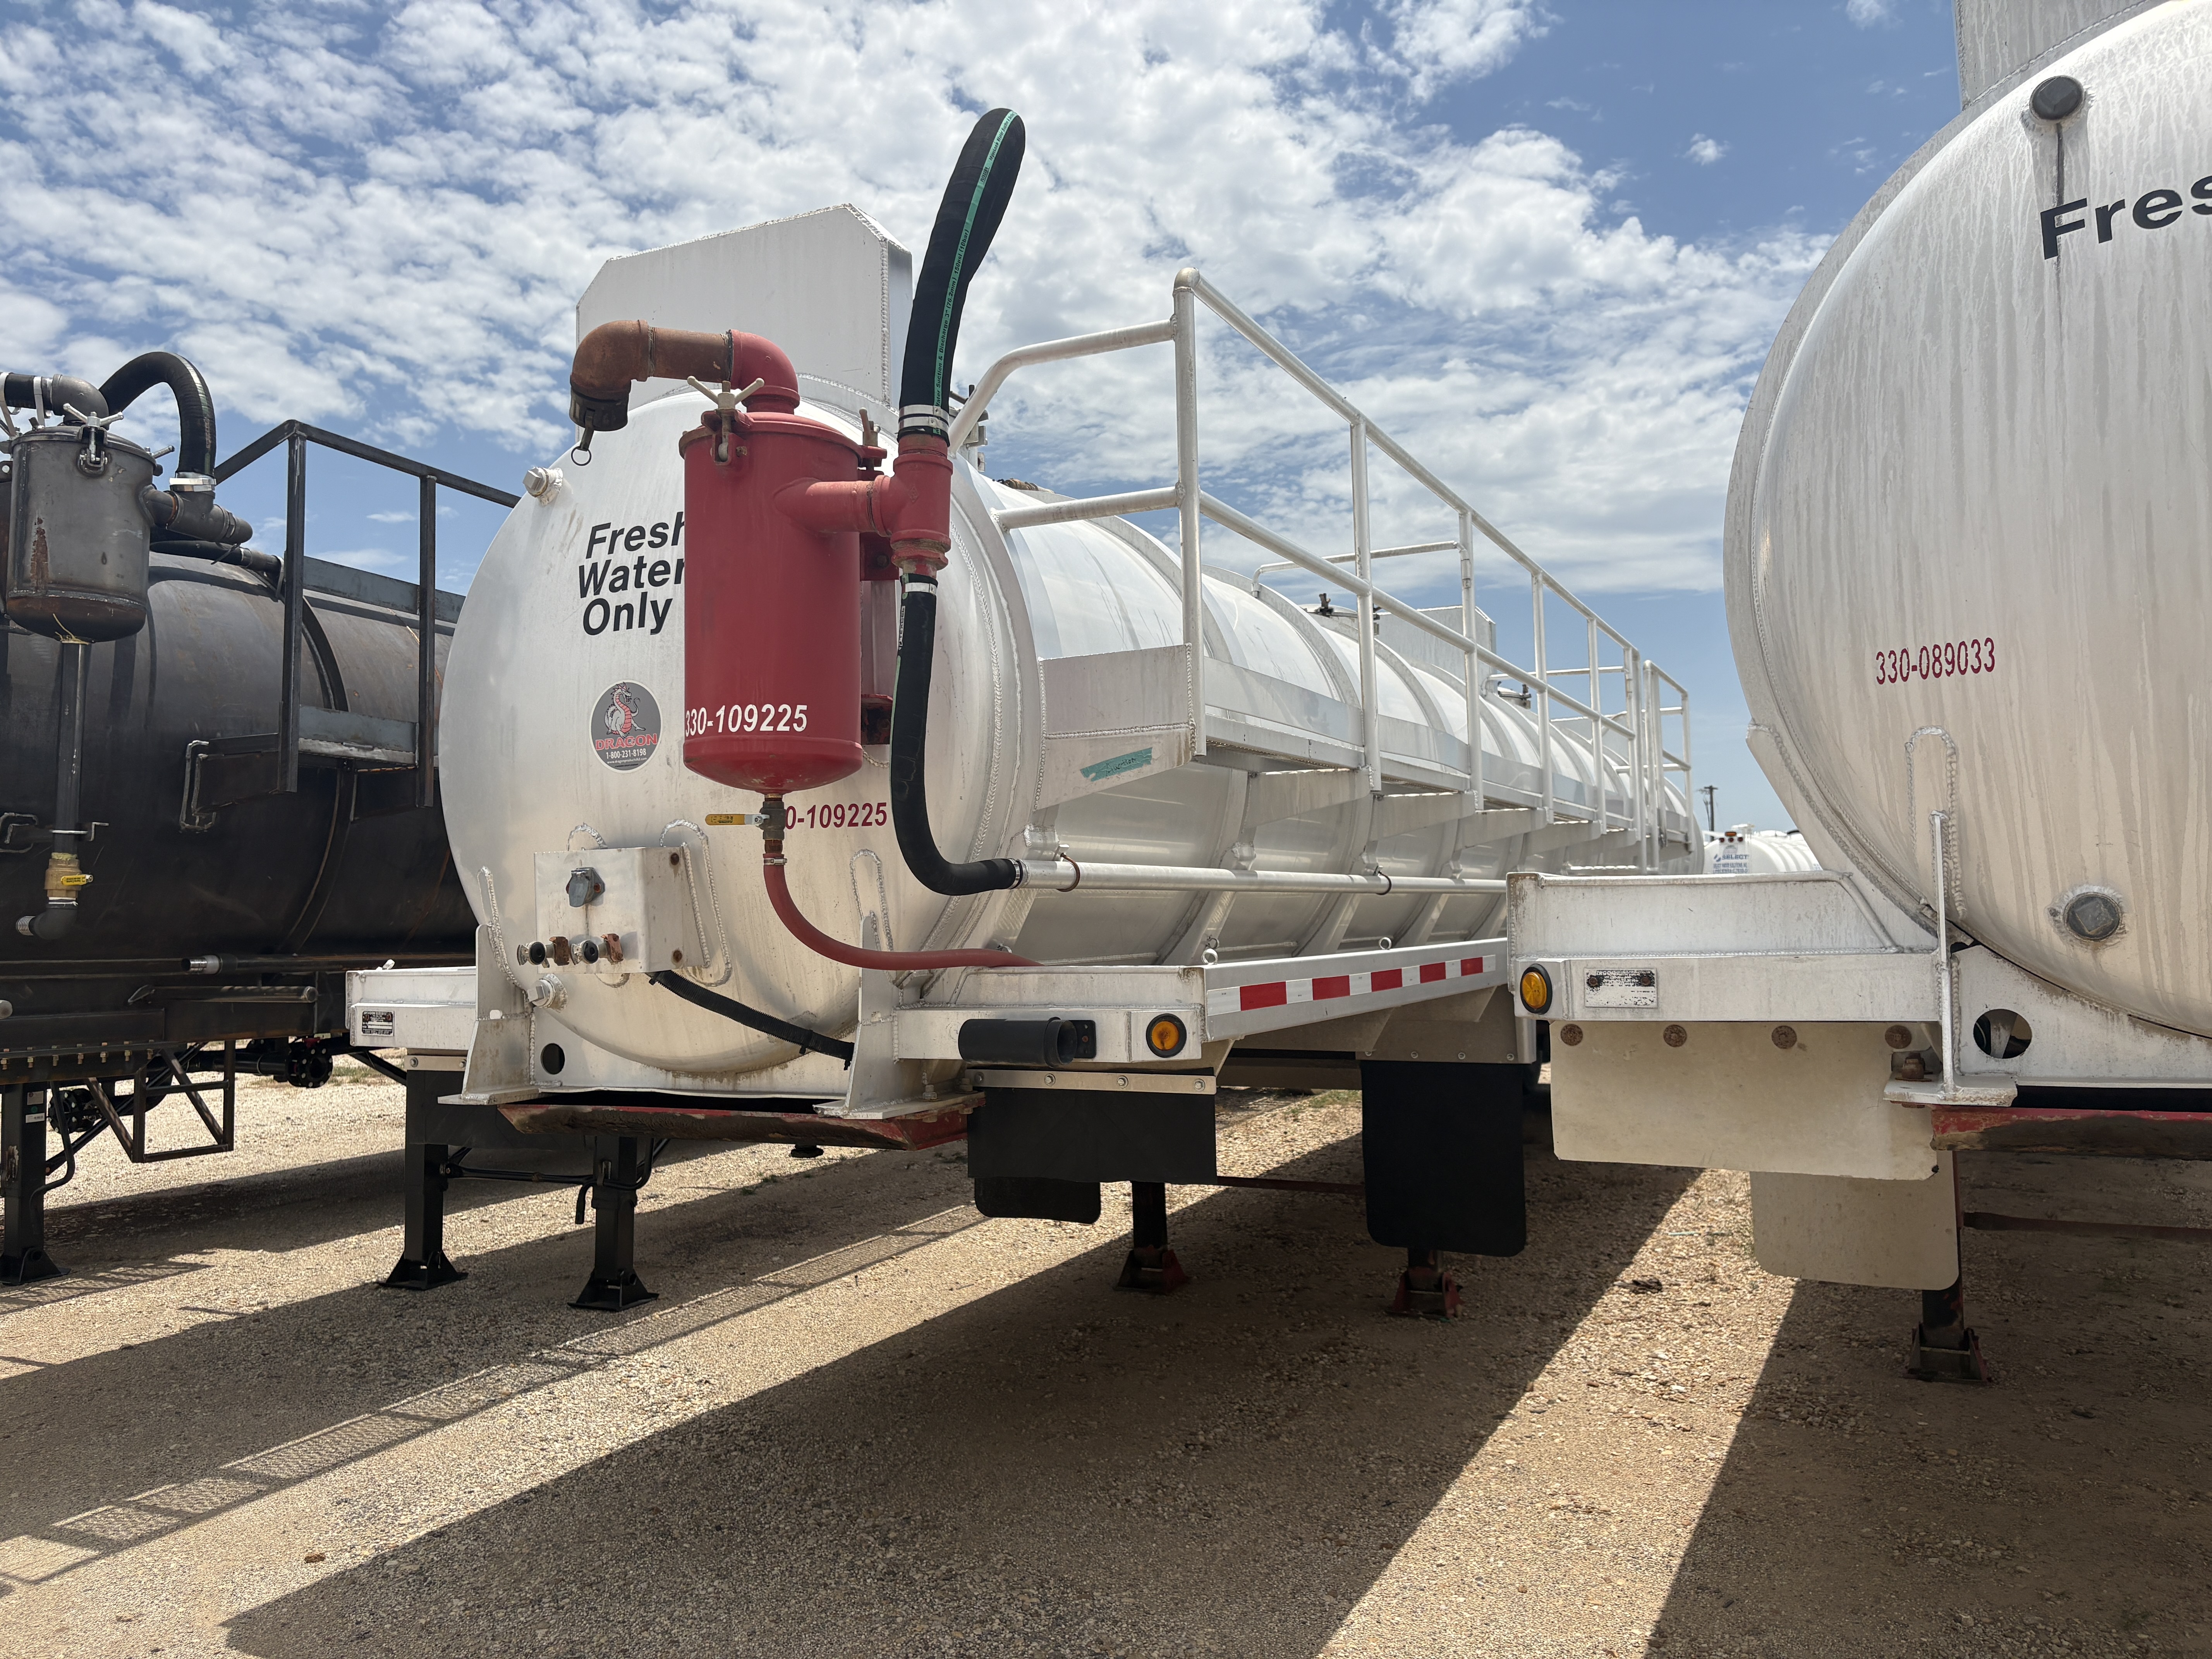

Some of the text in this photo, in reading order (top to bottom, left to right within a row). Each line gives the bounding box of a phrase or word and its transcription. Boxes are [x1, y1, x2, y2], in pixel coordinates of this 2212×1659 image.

[939, 320, 948, 353] Discharge
[959, 229, 969, 252] (10bar)
[586, 511, 685, 559] Fresh
[579, 556, 685, 598] Water
[583, 591, 673, 635] Only
[1876, 637, 1995, 685] 330-089033
[685, 704, 807, 737] 330-109225
[596, 734, 657, 750] DRAGON
[606, 748, 647, 759] 1-800-231-8198
[785, 802, 887, 830] 0-109225
